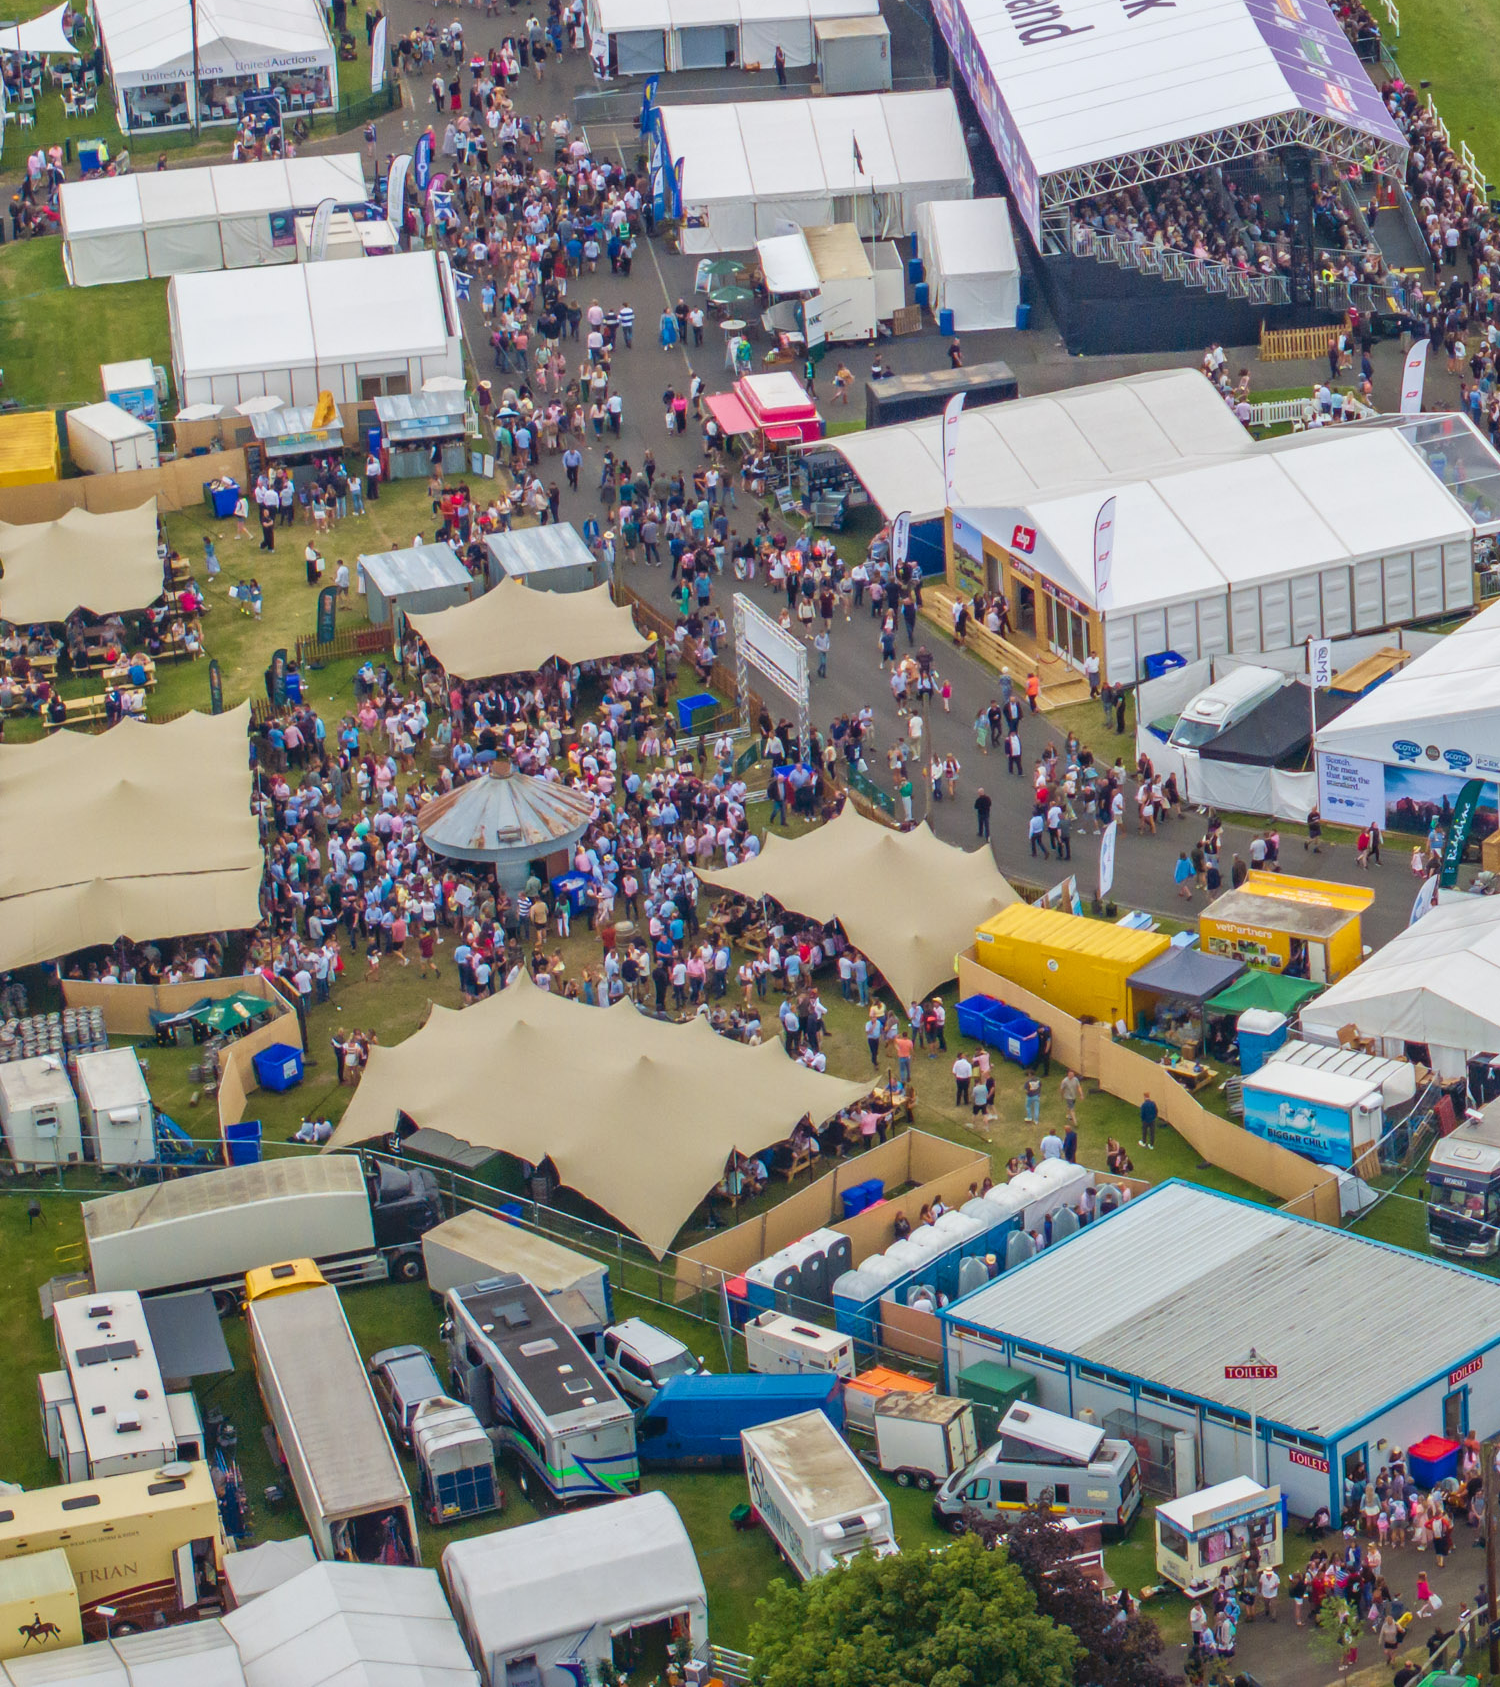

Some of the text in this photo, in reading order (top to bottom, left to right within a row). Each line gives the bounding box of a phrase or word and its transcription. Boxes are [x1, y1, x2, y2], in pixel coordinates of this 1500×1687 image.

[1316, 646, 1328, 684] QMS
[1393, 742, 1422, 754] SCOTCH
[1325, 755, 1350, 766] Scotch.
[1444, 751, 1472, 764] SCOTCH
[1326, 763, 1359, 775] The meat
[1326, 771, 1340, 779] that
[1357, 775, 1370, 784] the
[1447, 801, 1471, 861] Ridgeline
[1216, 922, 1272, 939] vetPartners
[1267, 1127, 1301, 1144] BIGGAR
[1303, 1136, 1329, 1151] CHILL
[1228, 1367, 1275, 1378] TOILETS
[1451, 1356, 1482, 1383] TOILETS
[1291, 1450, 1328, 1472] TOILETS
[75, 1561, 138, 1585] TRIAN
